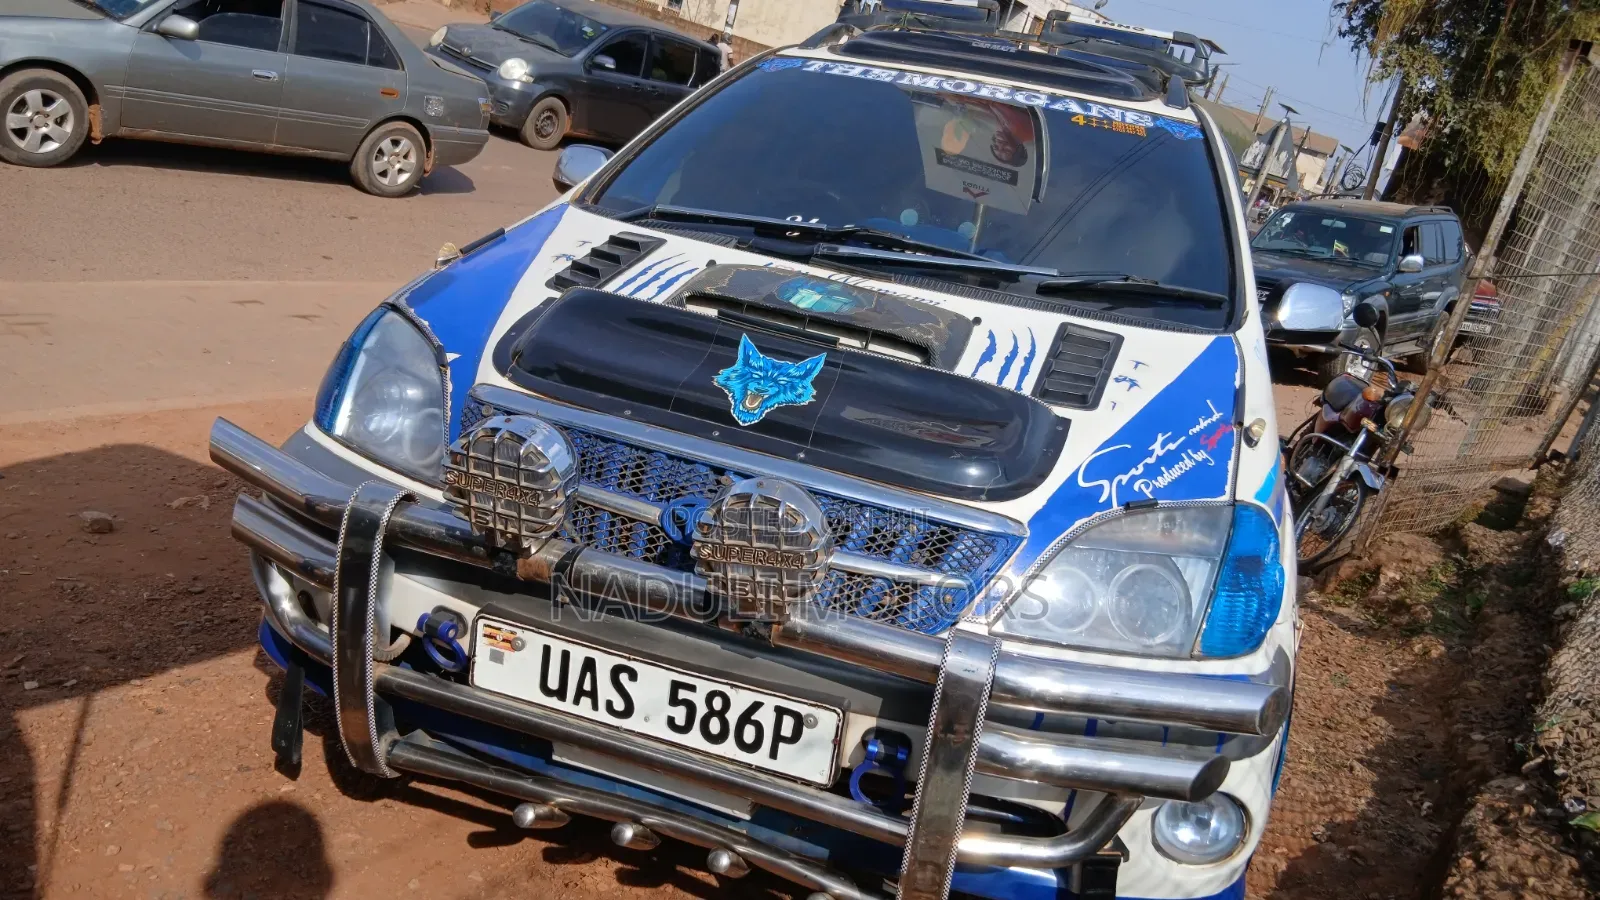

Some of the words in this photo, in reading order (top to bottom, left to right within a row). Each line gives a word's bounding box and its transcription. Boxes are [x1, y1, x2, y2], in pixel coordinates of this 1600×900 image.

[802, 60, 901, 83] THE
[1133, 452, 1197, 499] Produced
[1187, 449, 1215, 466] by
[538, 643, 639, 721] UAS
[666, 679, 805, 761] 586P
